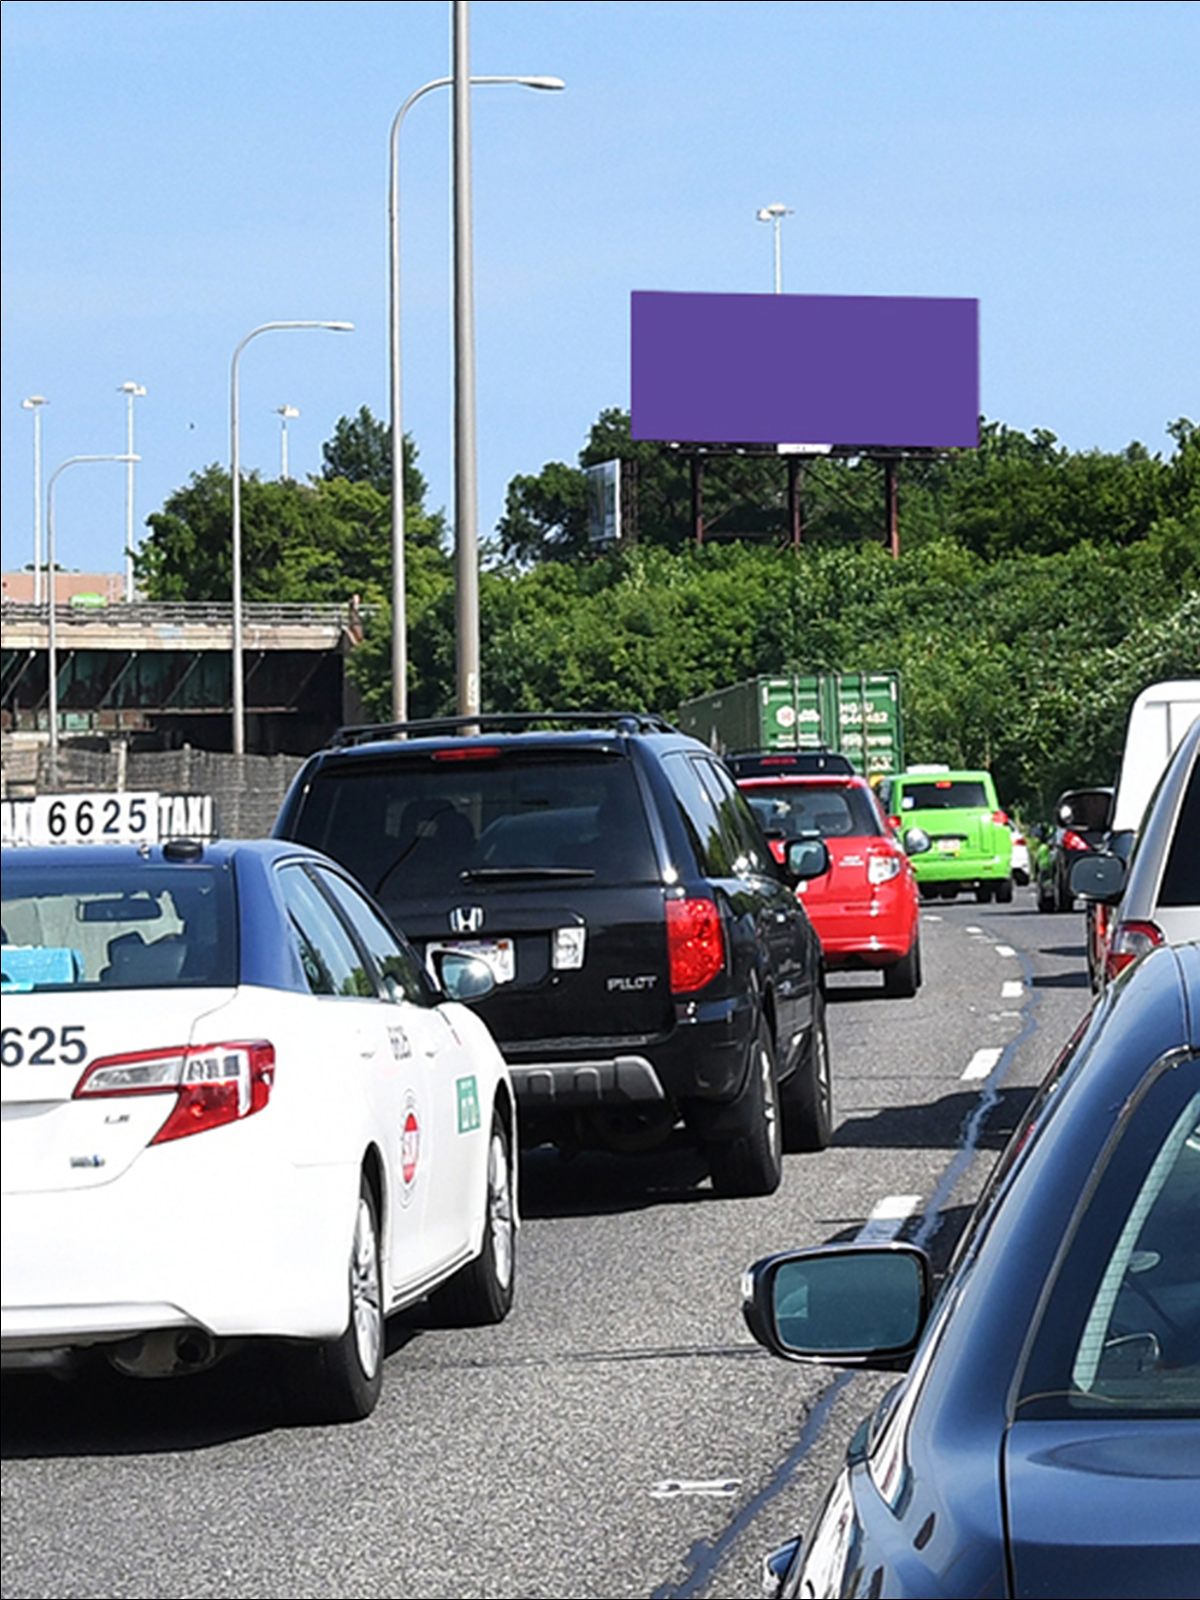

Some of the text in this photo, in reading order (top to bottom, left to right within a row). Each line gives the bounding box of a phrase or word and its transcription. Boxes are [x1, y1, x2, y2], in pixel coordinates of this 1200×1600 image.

[48, 798, 147, 837] 6625
[158, 795, 213, 836] TAXI
[606, 974, 658, 992] PILOT
[1, 1024, 88, 1068] 625
